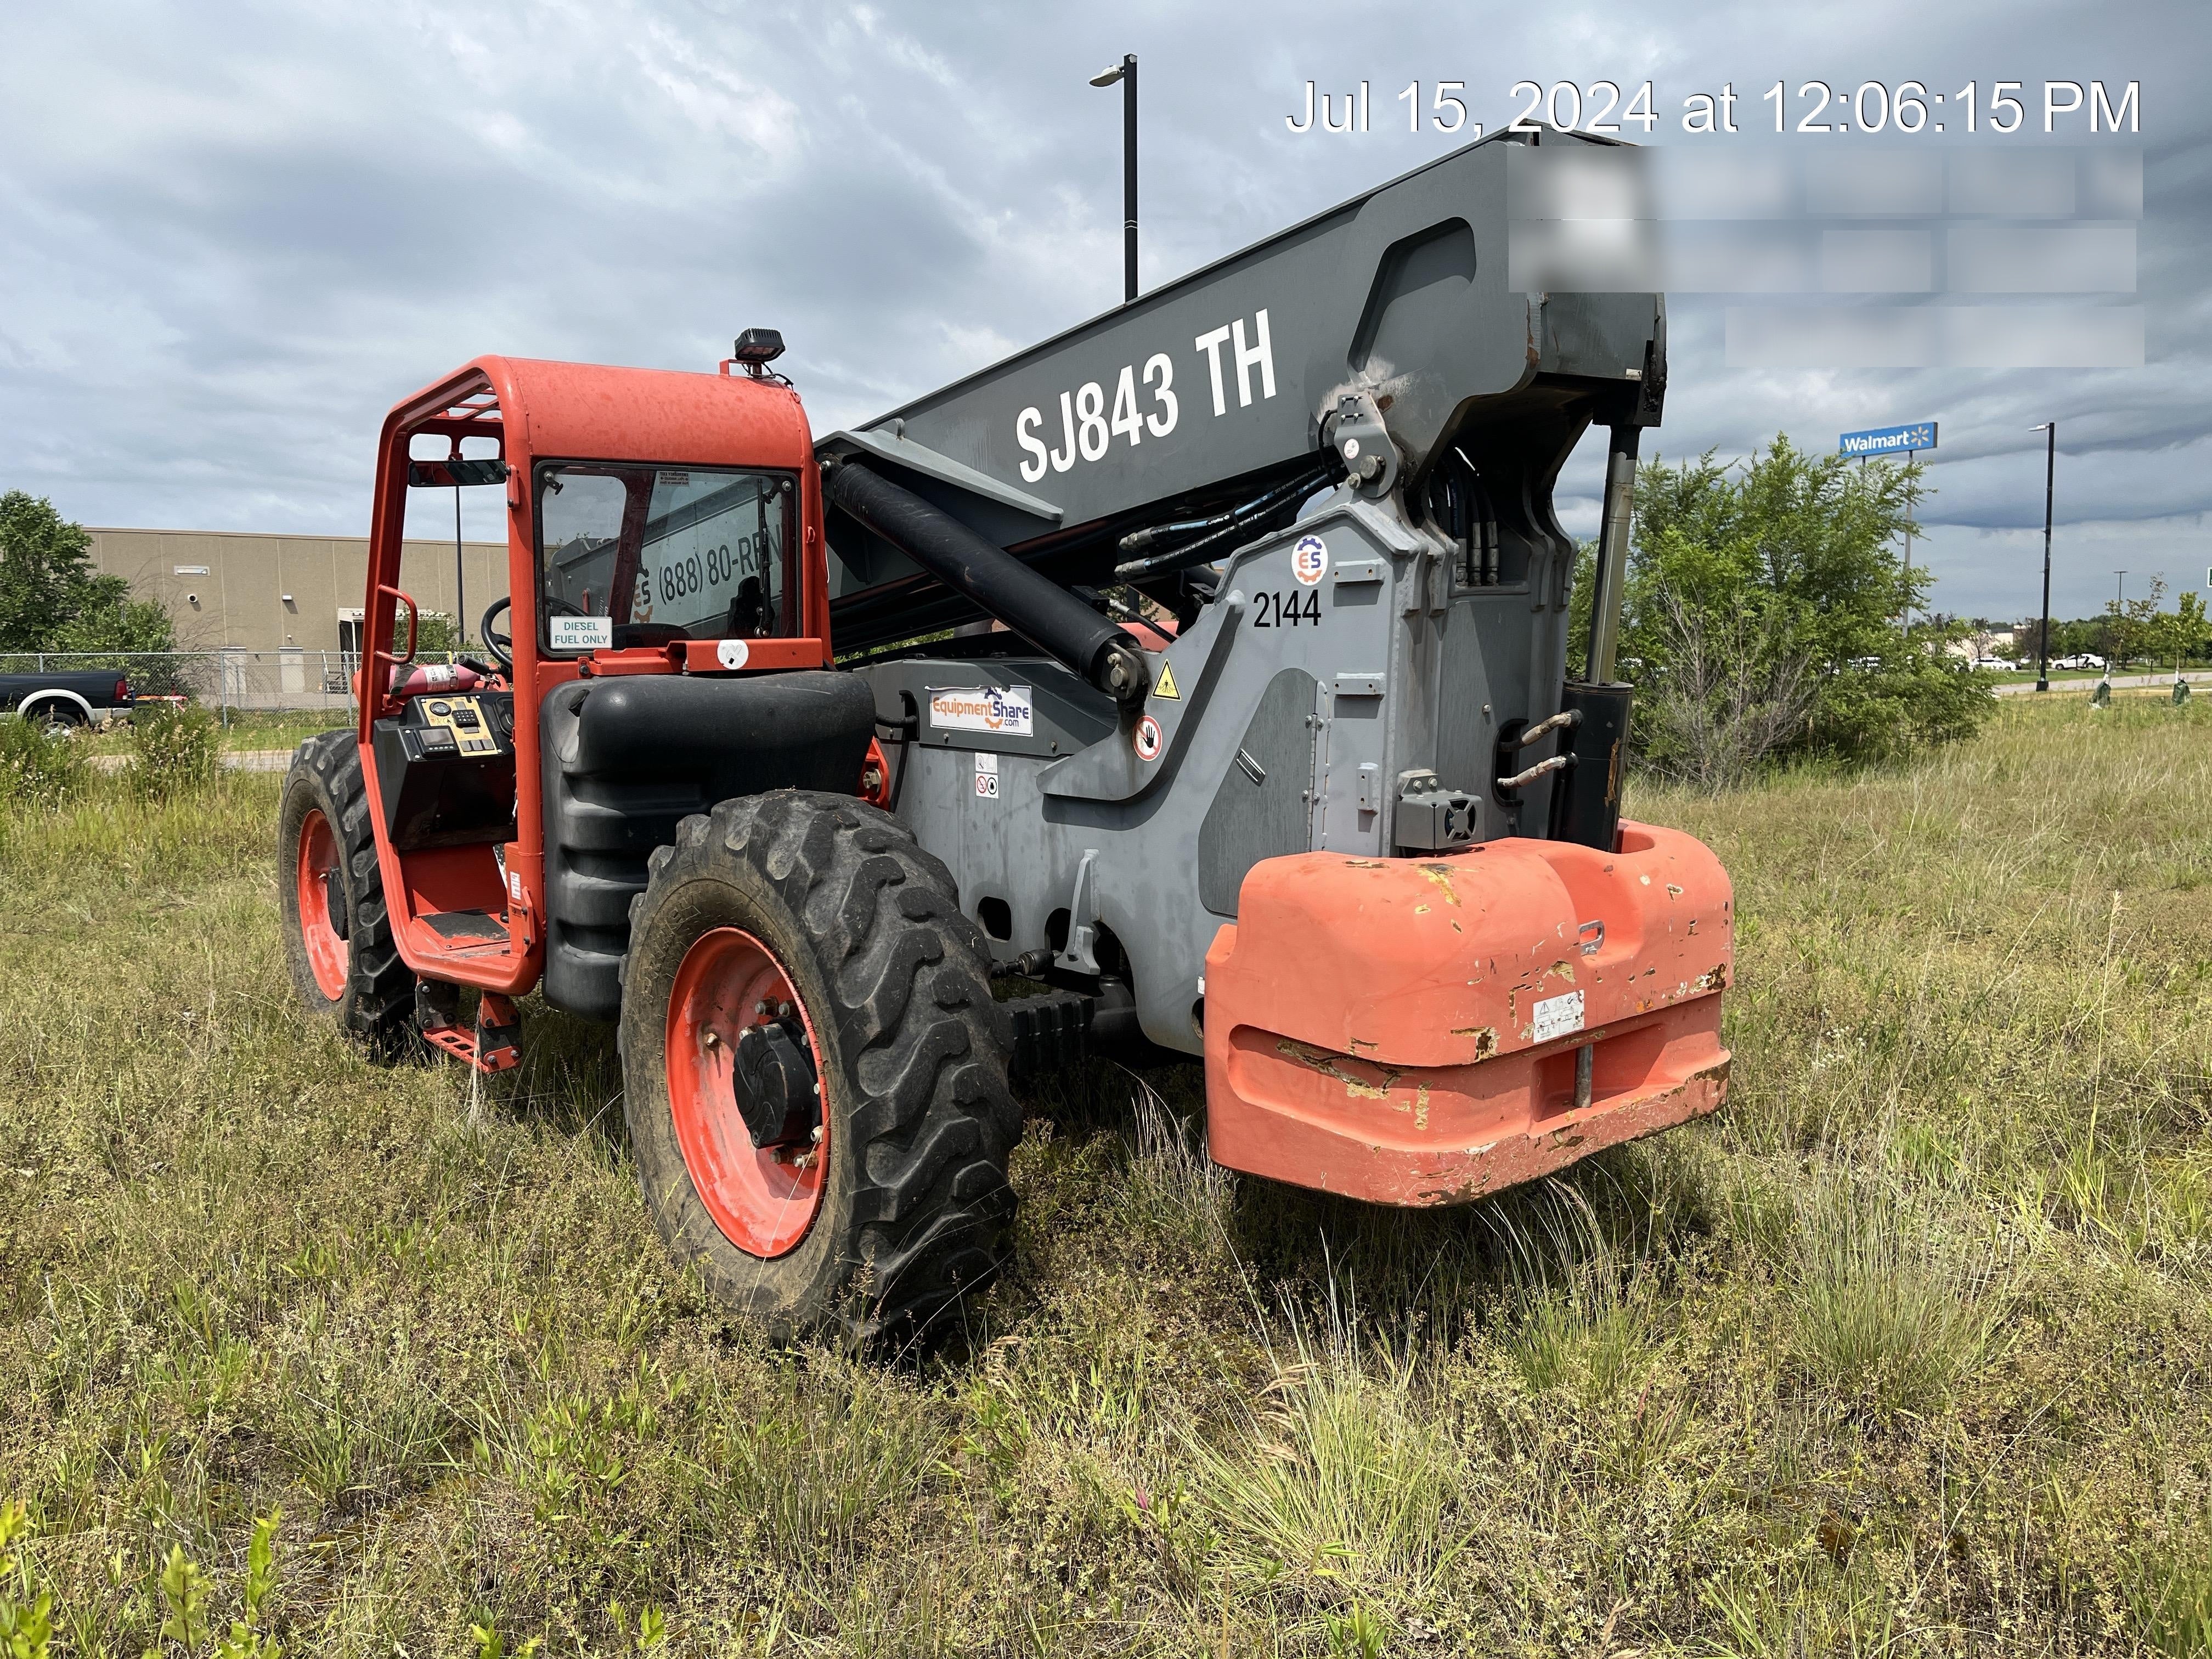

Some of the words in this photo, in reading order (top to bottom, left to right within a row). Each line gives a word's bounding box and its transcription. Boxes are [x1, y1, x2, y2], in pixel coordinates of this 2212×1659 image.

[1016, 352, 1178, 483] SJ843
[1195, 308, 1277, 417] TH
[1844, 431, 1909, 453] Walmart
[1298, 551, 1321, 569] ES
[659, 553, 703, 605] (888)
[1254, 589, 1321, 627] 2144
[564, 622, 599, 630] DIESEL
[555, 635, 579, 644] FUEL
[582, 635, 607, 644] ONLY
[933, 697, 1029, 719] EquipmentShare
[1003, 719, 1019, 727] .com
